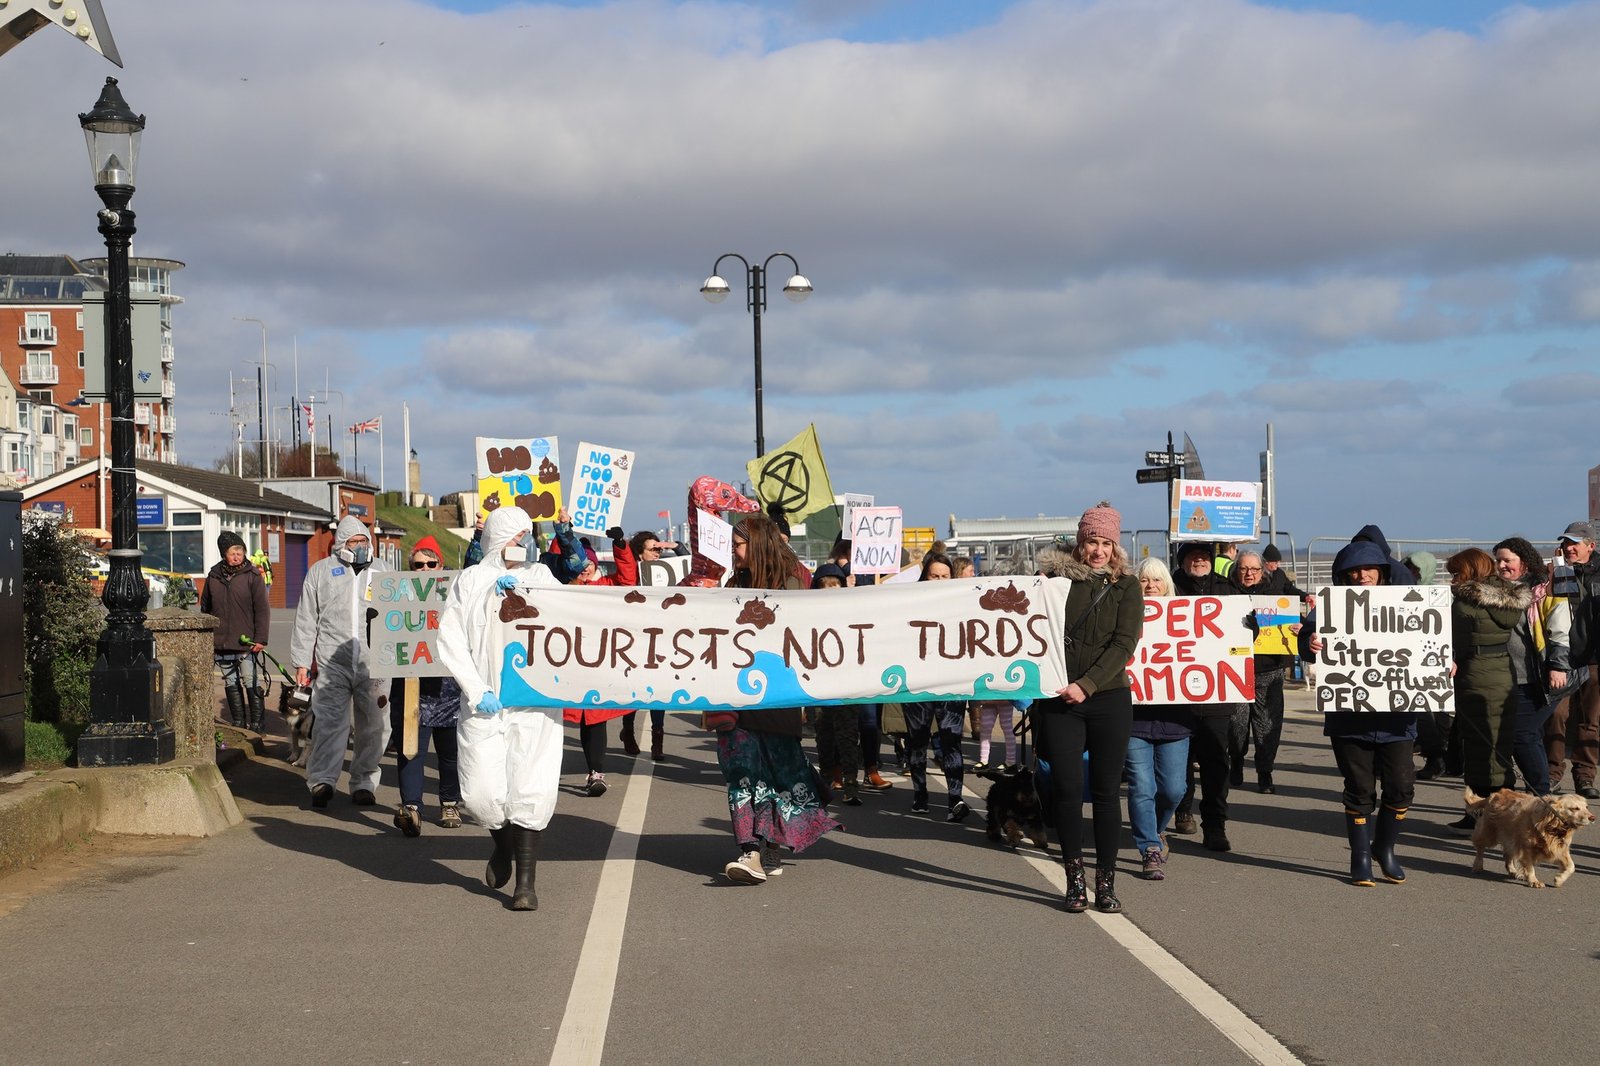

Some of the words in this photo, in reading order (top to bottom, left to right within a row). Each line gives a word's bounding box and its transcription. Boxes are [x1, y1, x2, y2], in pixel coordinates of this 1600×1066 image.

[589, 450, 611, 466] NO
[502, 473, 533, 496] TO
[580, 465, 613, 483] POO
[585, 482, 604, 497] IN
[576, 495, 611, 514] OUR
[573, 511, 607, 532] SEA
[856, 515, 901, 538] ACT
[854, 543, 897, 567] NOW
[379, 576, 450, 602] SAVE
[385, 609, 439, 632] OUR
[1318, 587, 1338, 634] 1
[1346, 588, 1443, 635] Million
[379, 640, 434, 666] SEA
[515, 624, 757, 670] TOURISTS
[783, 623, 875, 670] NOT
[908, 614, 1048, 661] TURDS
[1321, 637, 1413, 668] Litres
[1317, 686, 1377, 712] PER
[1389, 689, 1454, 712] DAY
